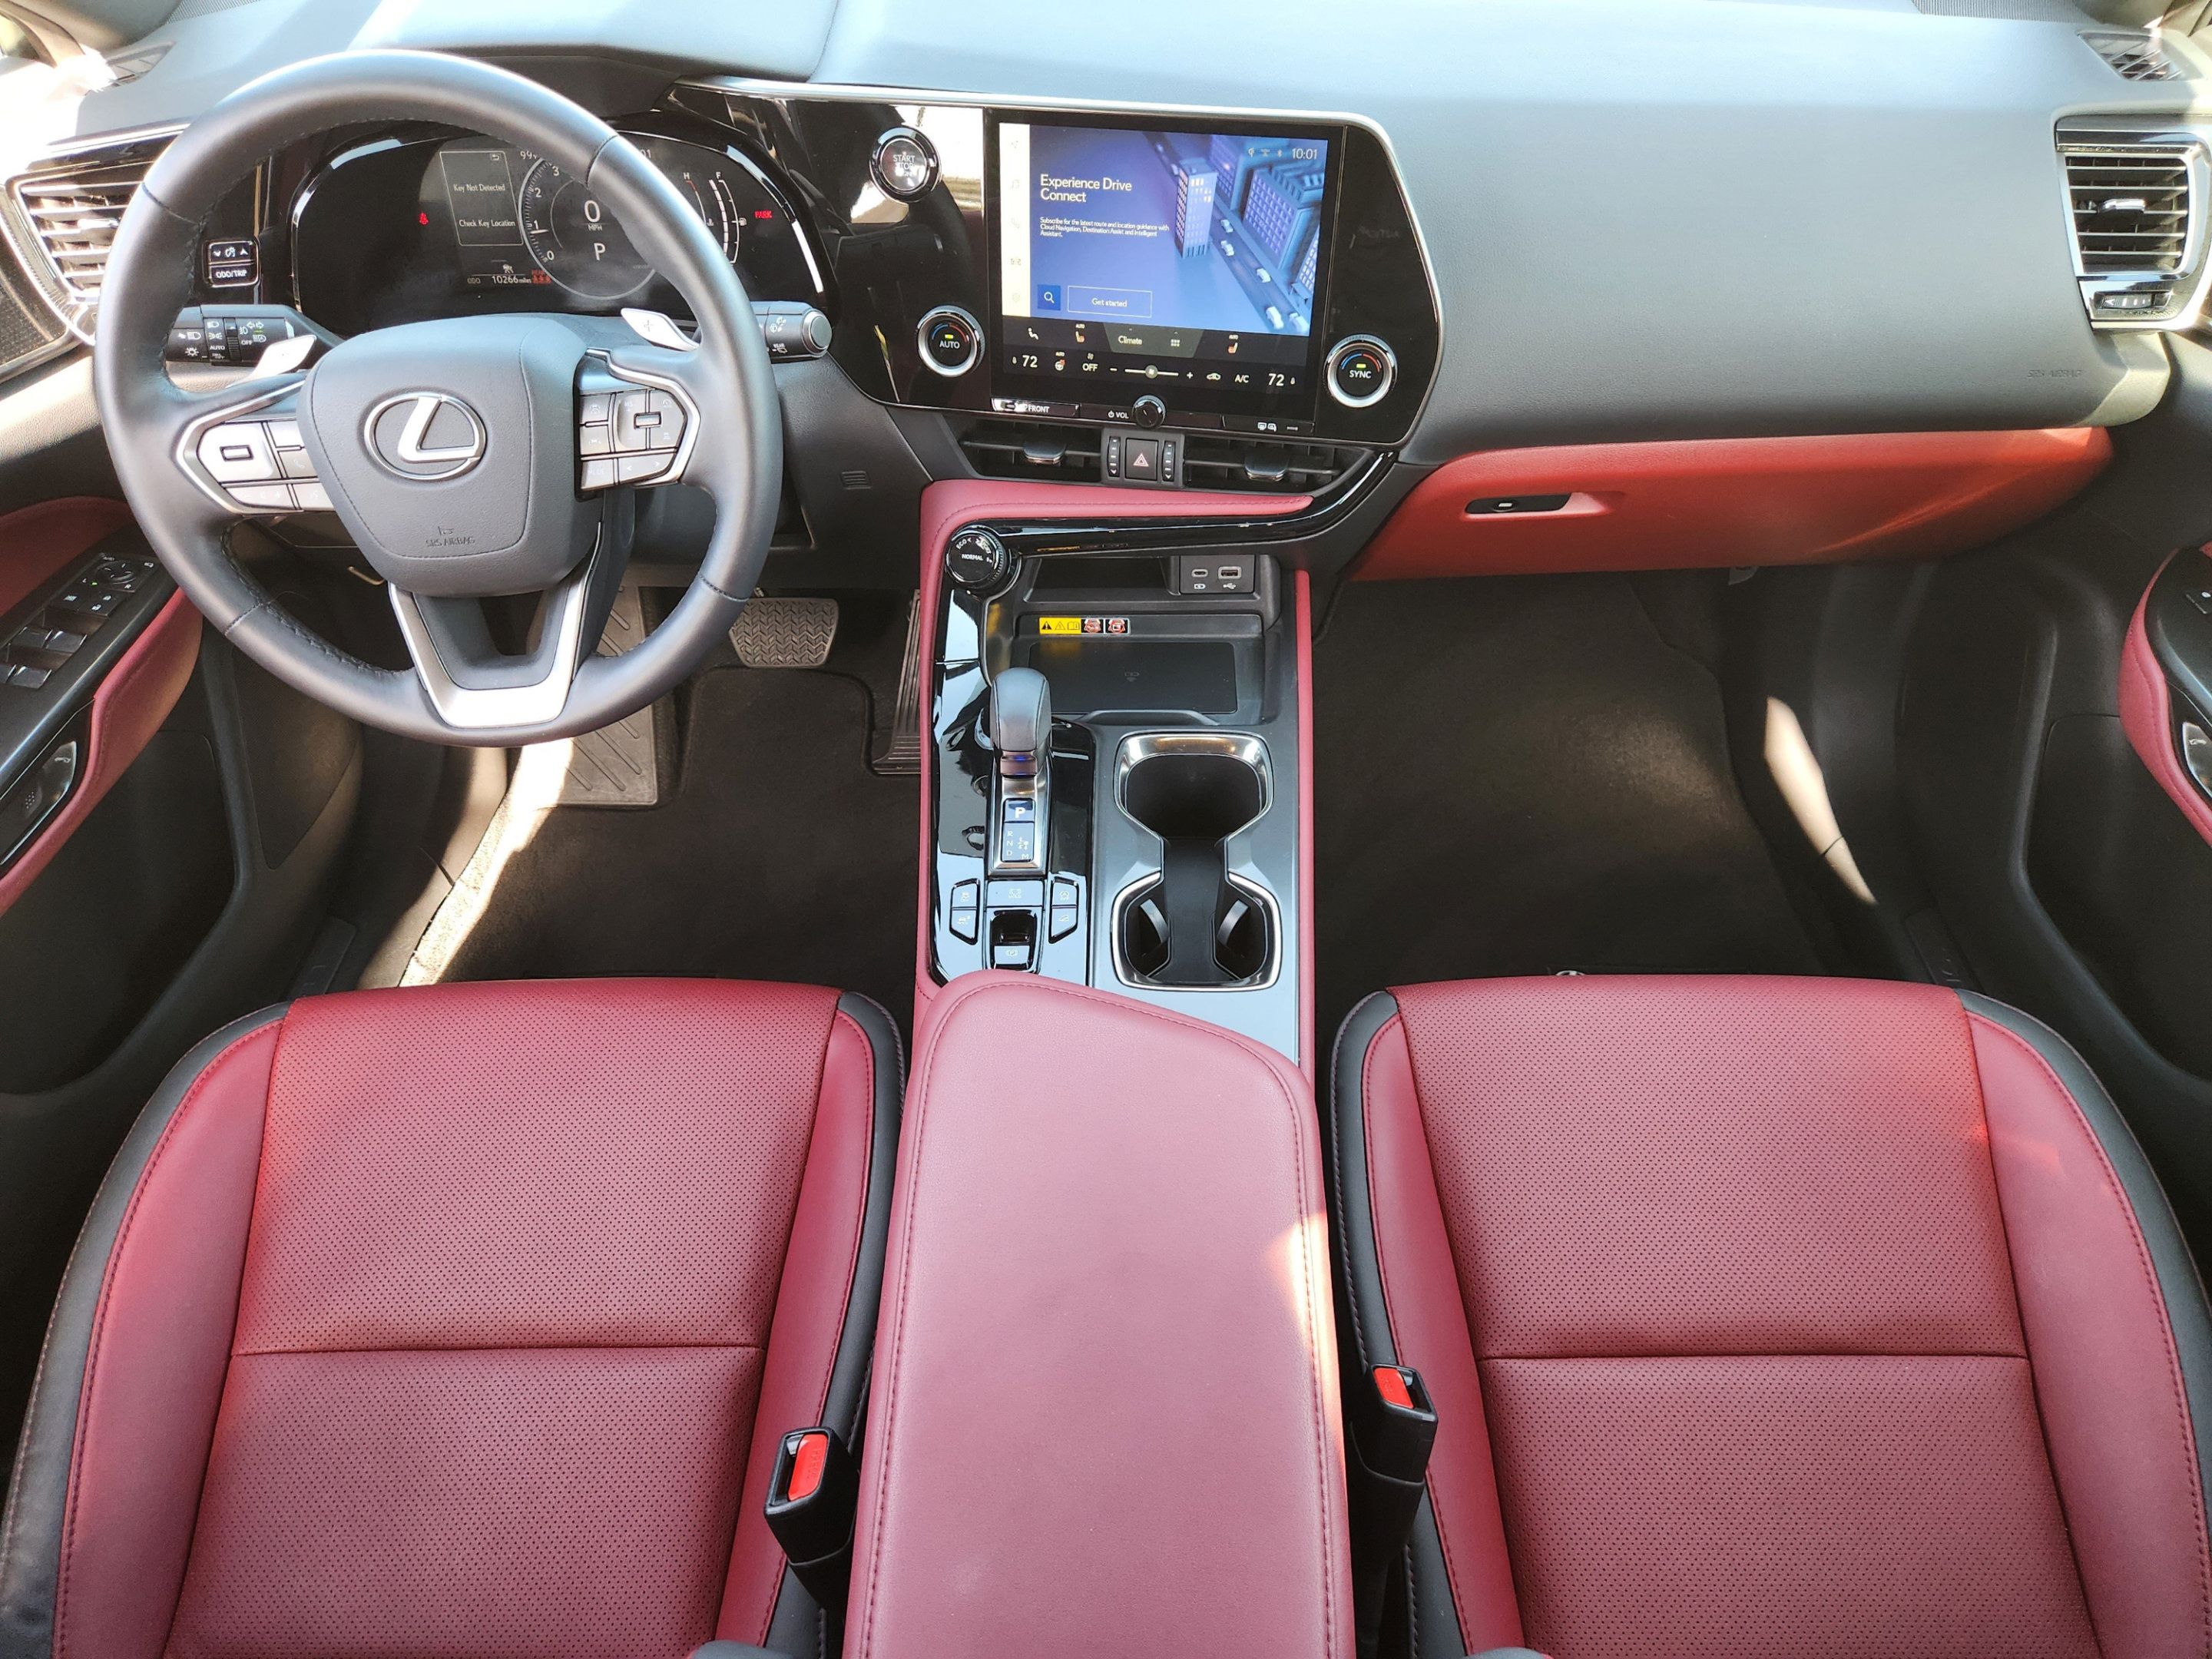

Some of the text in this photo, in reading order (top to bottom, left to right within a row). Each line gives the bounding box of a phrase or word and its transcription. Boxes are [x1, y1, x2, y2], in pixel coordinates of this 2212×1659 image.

[1292, 147, 1318, 160] 10:01
[551, 166, 560, 177] 3
[1040, 174, 1132, 191] Experience Drive
[454, 184, 465, 193] Key
[535, 187, 542, 197] 2
[1040, 187, 1087, 202] Connect
[584, 200, 601, 223] 0
[754, 210, 773, 219] PARK
[459, 219, 477, 227] Check
[478, 219, 489, 228] Key
[533, 220, 539, 229] 1
[546, 250, 555, 260] 0
[593, 243, 606, 260] P
[215, 270, 247, 279] ODO/TRIP
[492, 275, 519, 284] 10266
[1091, 297, 1104, 306] Get
[939, 340, 960, 349] AUTO
[1118, 335, 1143, 345] Climate
[1022, 355, 1038, 368] 72
[1082, 363, 1098, 372] OFF
[1234, 374, 1250, 383] A/C
[1349, 369, 1372, 379] SYNC
[1268, 373, 1285, 386] 72
[1028, 403, 1050, 413] FRONT
[1115, 411, 1129, 419] VOL
[955, 538, 967, 550] ECO
[1015, 806, 1026, 819] P
